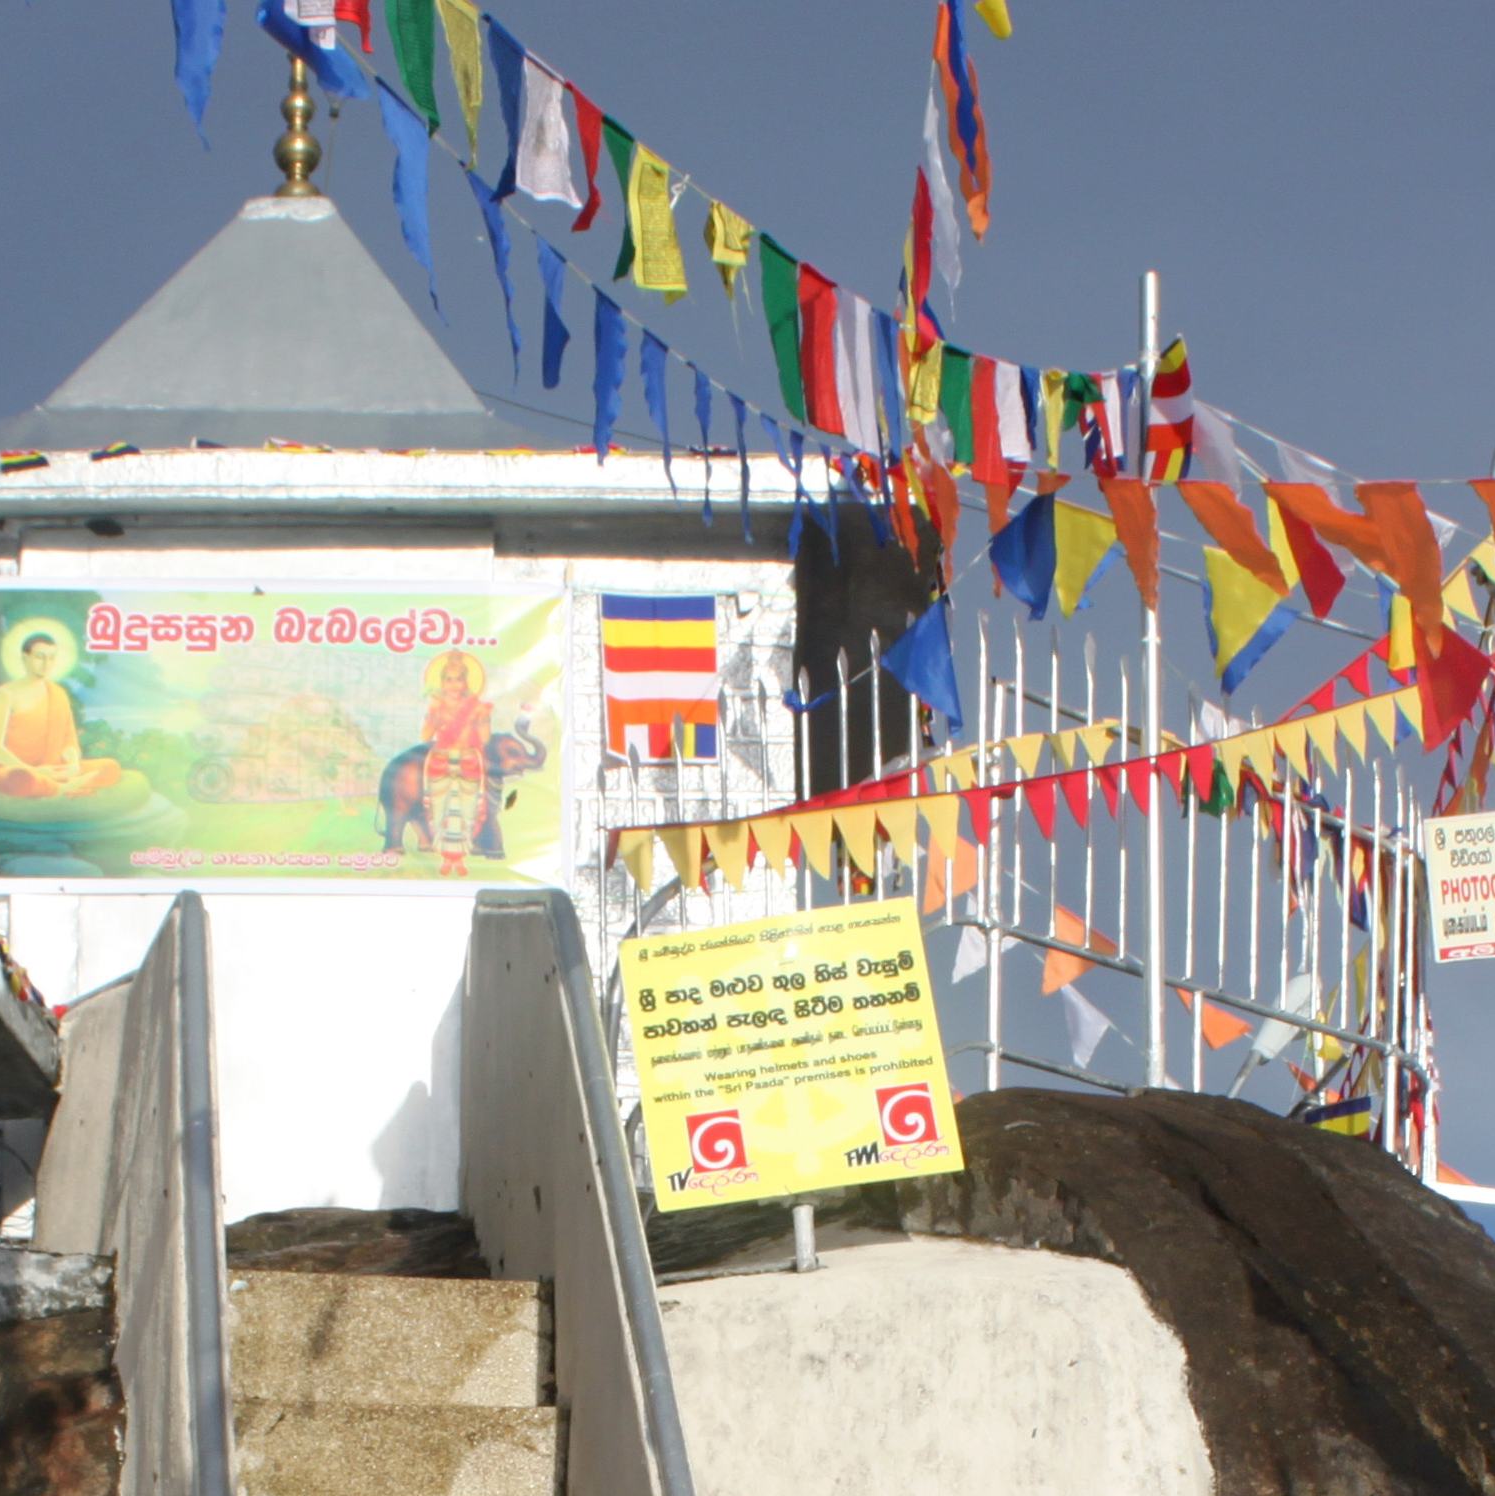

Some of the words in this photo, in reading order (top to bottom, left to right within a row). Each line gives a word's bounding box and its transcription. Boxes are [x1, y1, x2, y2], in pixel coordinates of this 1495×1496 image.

[86, 603, 254, 654] බුදුසසුන
[664, 987, 703, 1005] පාද
[653, 1091, 691, 1103] within
[694, 1088, 714, 1098] the
[793, 1069, 851, 1085] premises
[854, 1067, 865, 1075] is
[869, 1055, 933, 1075] prohibited
[704, 1068, 756, 1082] Wearing
[759, 1060, 809, 1074] helmets
[812, 1055, 836, 1067] and
[839, 1051, 877, 1063] shoes
